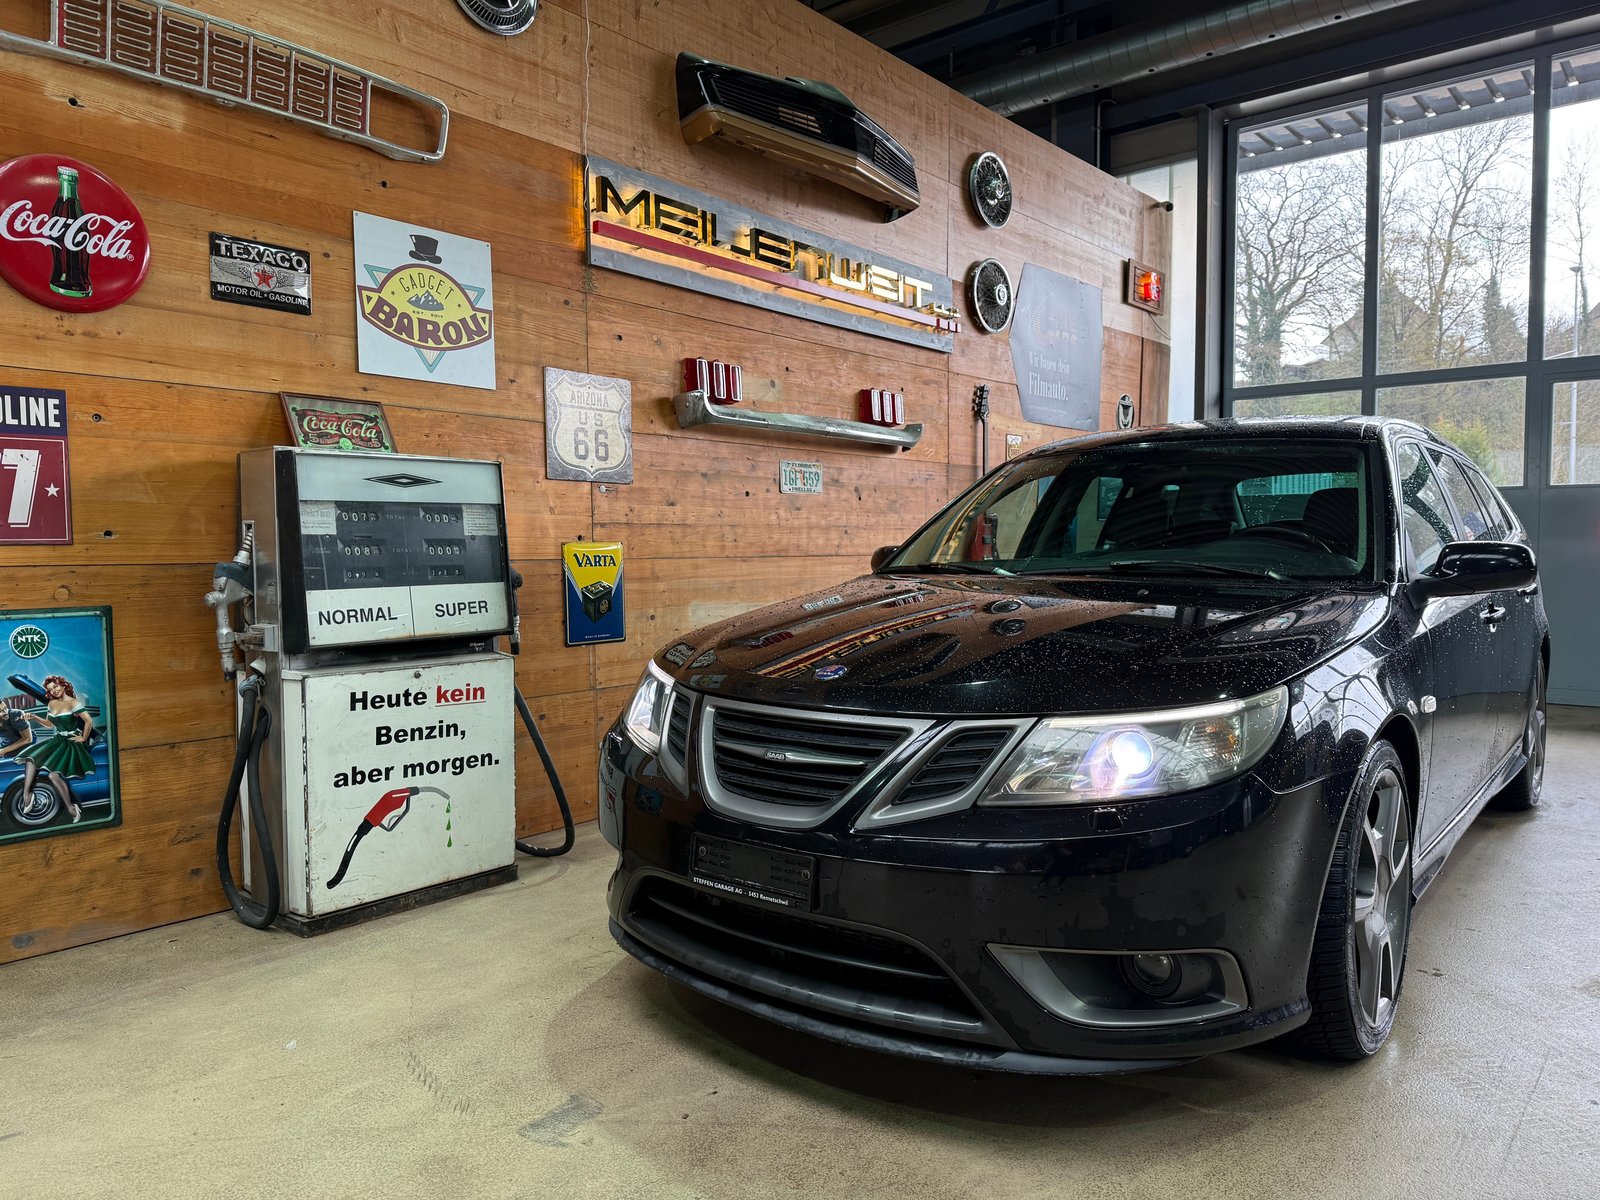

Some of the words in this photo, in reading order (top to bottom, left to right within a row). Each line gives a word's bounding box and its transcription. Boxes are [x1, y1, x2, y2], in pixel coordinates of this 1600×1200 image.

[0, 200, 135, 260] Coca-Cola
[595, 175, 933, 308] MEILENWEIT
[215, 240, 308, 273] TEXACO
[217, 284, 248, 296] MOTOR
[250, 290, 263, 299] OIL
[269, 293, 309, 307] GASOLINE
[399, 272, 455, 299] GADGET
[367, 295, 488, 345] BARON
[570, 390, 609, 408] ARIZONA
[1029, 372, 1069, 401] Filmauto.
[0, 395, 61, 428] LINE
[579, 412, 588, 426] U
[594, 413, 603, 427] S
[303, 416, 378, 438] Coca-Cola
[574, 427, 609, 462] 66
[573, 553, 617, 568] VARTA
[318, 606, 398, 626] NORMAL
[435, 601, 489, 618] SUPER
[18, 635, 41, 643] NTK
[350, 688, 428, 712] Heute
[436, 683, 486, 704] kein
[375, 720, 466, 746] Benzin,
[766, 752, 785, 760] SAAB
[333, 766, 395, 788] aber
[403, 752, 500, 779] morgen.
[693, 877, 714, 887] STEFFEN
[714, 883, 734, 893] GARAGE
[748, 891, 759, 899] 5453
